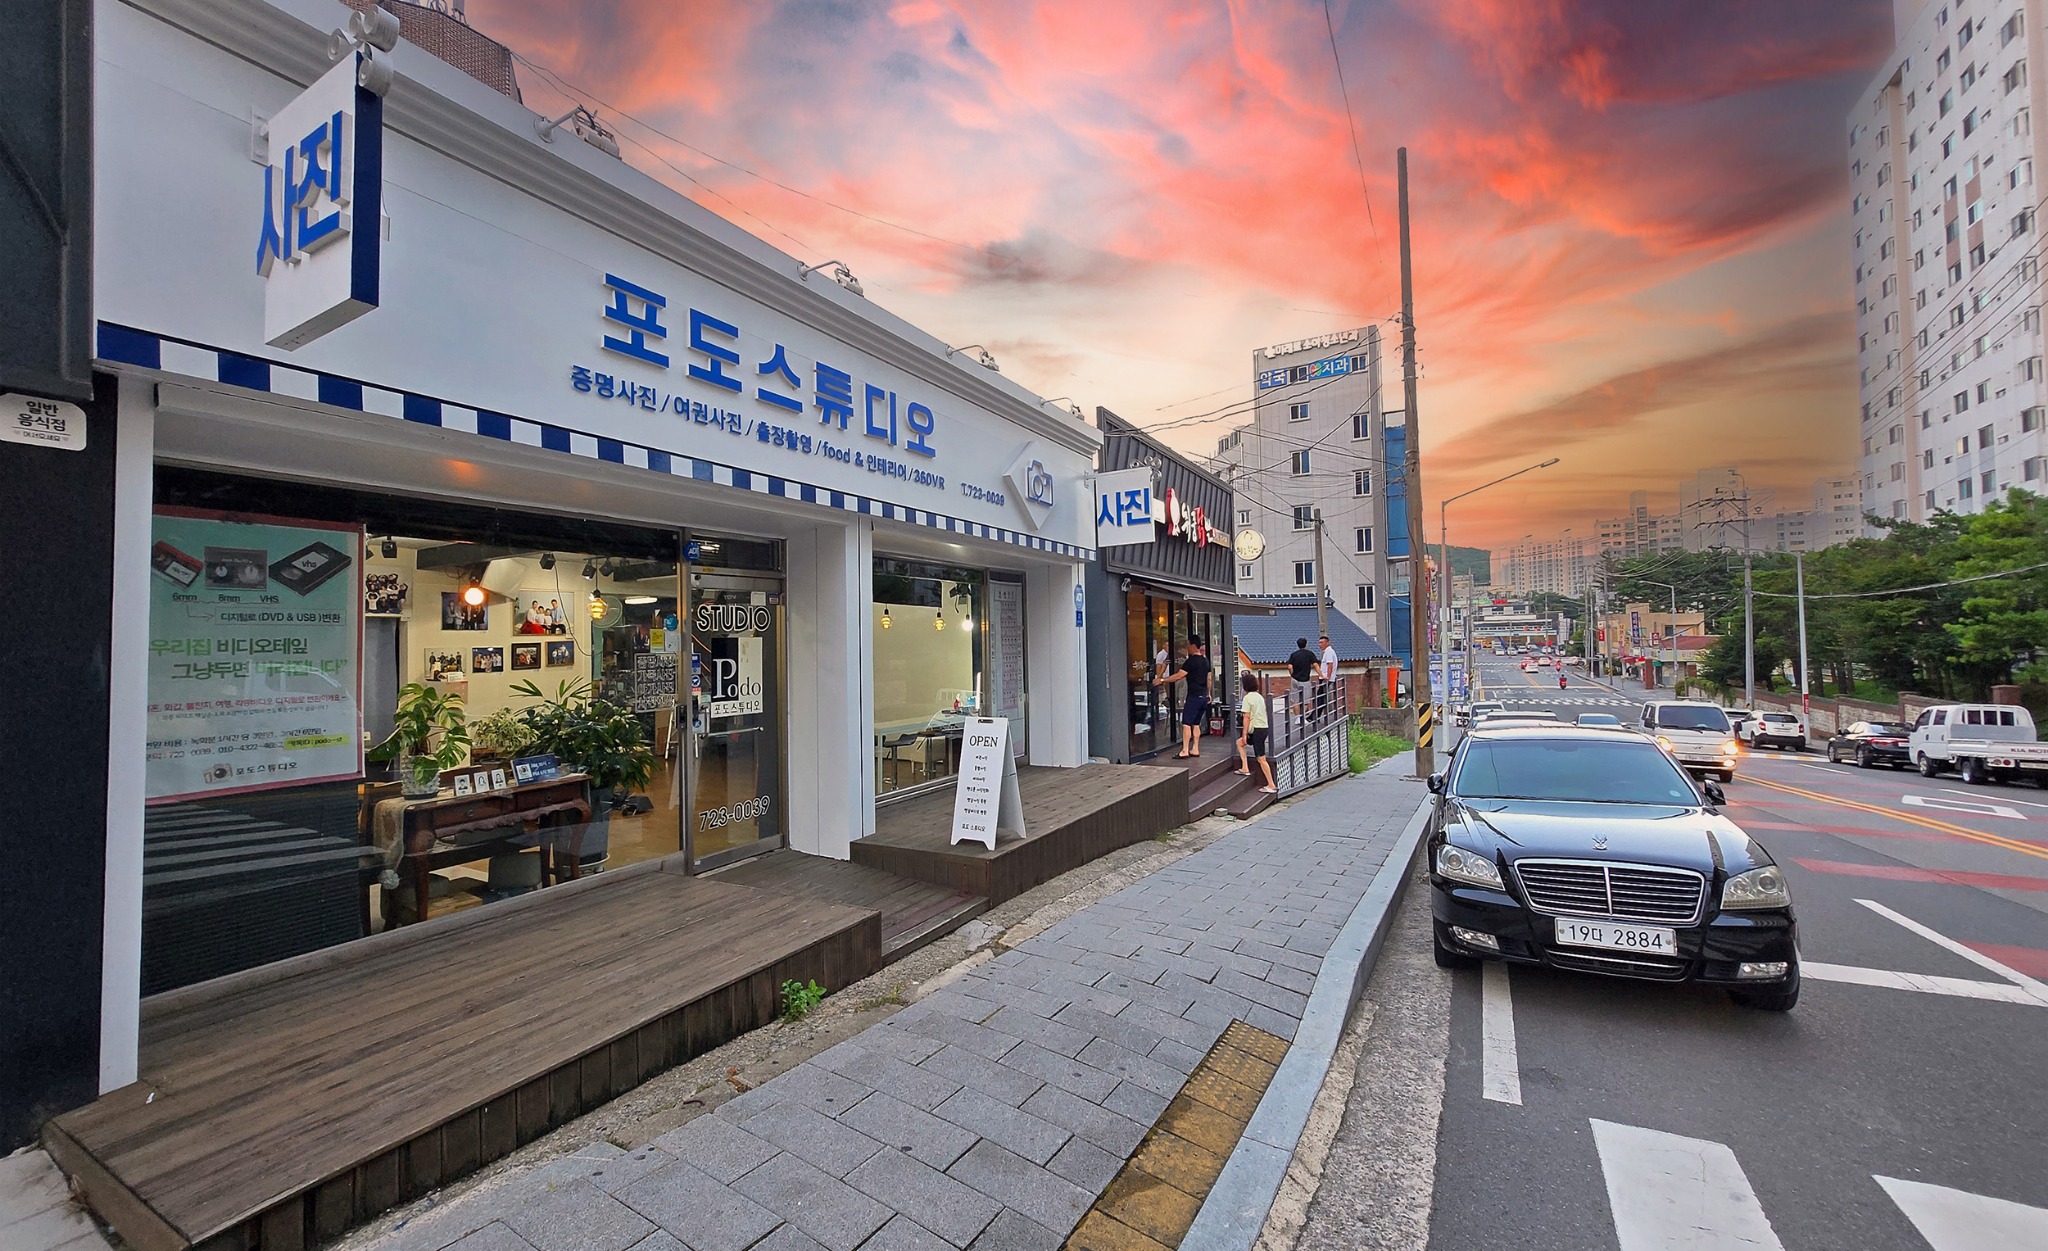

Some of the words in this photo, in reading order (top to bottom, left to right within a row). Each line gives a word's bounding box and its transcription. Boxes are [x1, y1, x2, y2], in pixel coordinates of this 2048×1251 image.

[257, 110, 346, 277] 사진
[1303, 329, 1359, 351] 소아청소년과
[601, 272, 936, 459] 포도스튜디오
[1322, 357, 1349, 374] 치과
[1260, 370, 1286, 386] 약국
[26, 401, 59, 417] 일반
[571, 365, 657, 411] 증명사진
[855, 451, 864, 467] &
[1098, 487, 1151, 527] 사진
[302, 559, 317, 568] vhs
[172, 593, 198, 602] 6mm
[218, 593, 240, 603] 8mm
[260, 595, 280, 603] VHS
[220, 613, 256, 622] 디지털로
[286, 613, 294, 622] &
[697, 603, 772, 632] STUDIO
[217, 638, 308, 655] 비디오테잎
[172, 660, 251, 680] 그냥두면
[712, 658, 762, 699] Podo
[714, 701, 760, 715] 포도스튜디오
[969, 735, 999, 747] OPEN
[236, 762, 298, 775] 포도스튜디오
[699, 795, 771, 832] 723-0039
[1568, 924, 1604, 943] 19다
[1613, 929, 1663, 950] 2884
